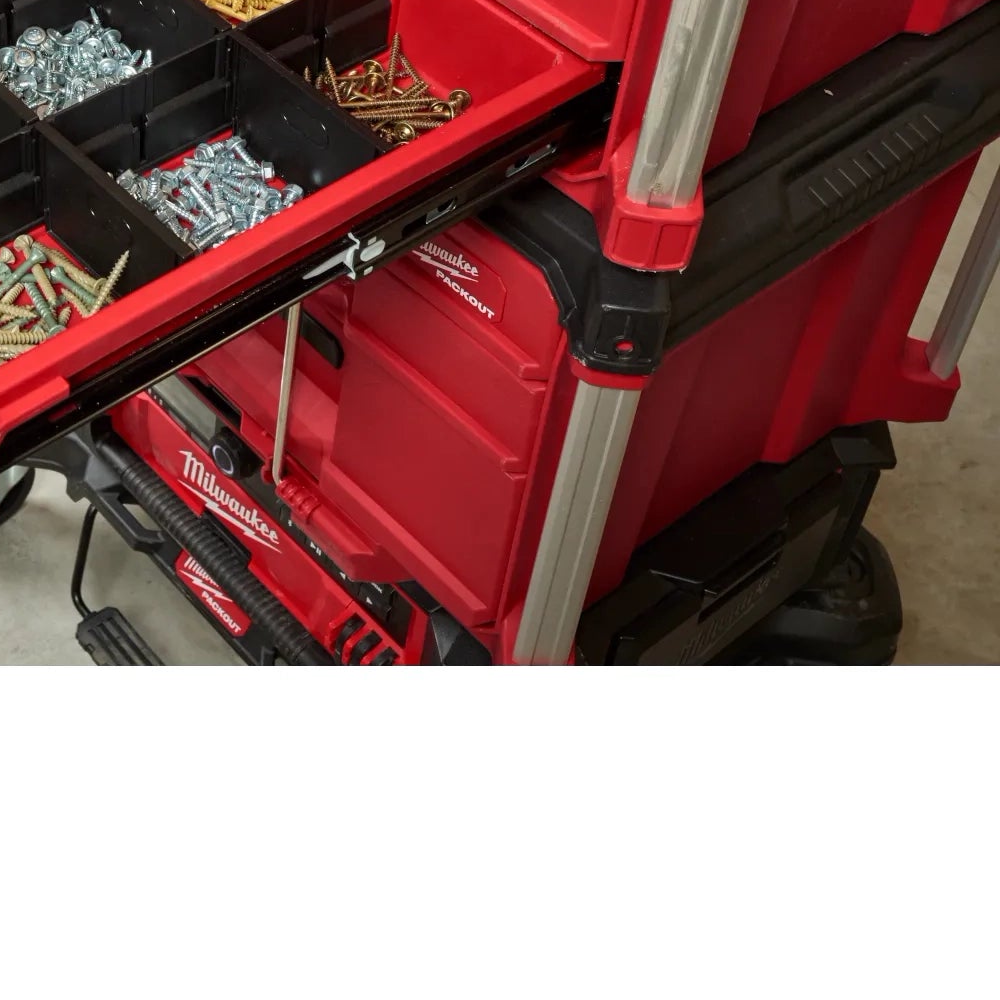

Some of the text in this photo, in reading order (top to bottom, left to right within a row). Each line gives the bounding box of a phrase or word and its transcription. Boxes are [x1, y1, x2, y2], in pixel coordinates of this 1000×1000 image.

[436, 268, 495, 319] PACKOUT
[178, 450, 280, 545] Milwaukee
[201, 590, 242, 633] PACKOUT
